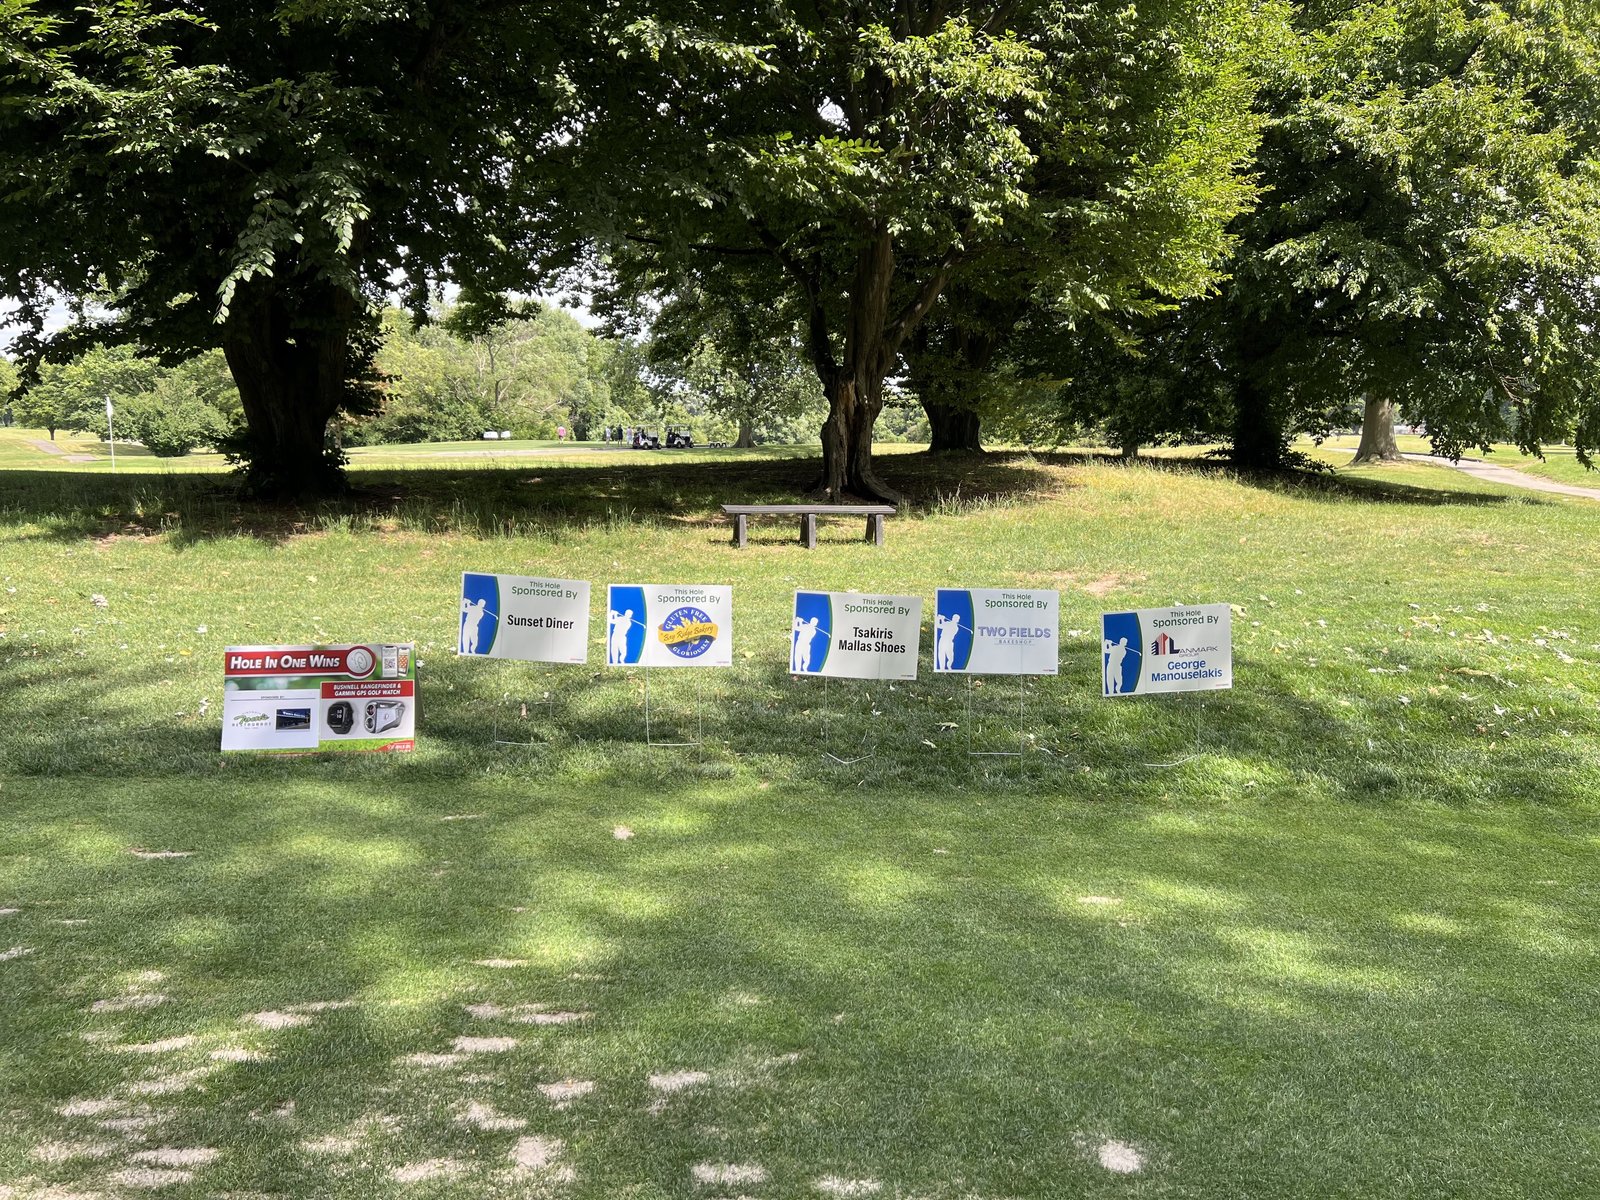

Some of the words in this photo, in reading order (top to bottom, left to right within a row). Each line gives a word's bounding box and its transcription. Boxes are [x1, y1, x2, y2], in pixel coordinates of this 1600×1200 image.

[511, 586, 563, 598] Sponsored
[565, 590, 578, 599] By
[657, 595, 707, 604] Sponsored
[709, 595, 721, 604] By
[985, 599, 1034, 609] Sponsored
[1036, 600, 1048, 609] By
[844, 604, 896, 614] Sponsored
[898, 606, 910, 616] By
[507, 614, 544, 628] Sunset
[546, 617, 574, 630] Diner
[665, 609, 688, 629] GLUTEN
[690, 609, 708, 622] FREE
[1152, 616, 1204, 628] Sponsored
[1207, 615, 1219, 624] By
[694, 624, 714, 635] Bakery
[853, 626, 893, 639] Tsakiris
[978, 626, 1007, 637] TWO
[1009, 627, 1051, 638] FIELDS
[672, 639, 710, 656] GLORIOUSLY
[838, 640, 872, 652] Mallas
[874, 641, 906, 653] Shoes
[230, 656, 262, 669] HOLE
[265, 656, 278, 669] IN
[280, 655, 306, 668] ONE
[309, 654, 340, 668] WINS
[1167, 660, 1206, 671] George
[1151, 668, 1223, 682] Manouselakis
